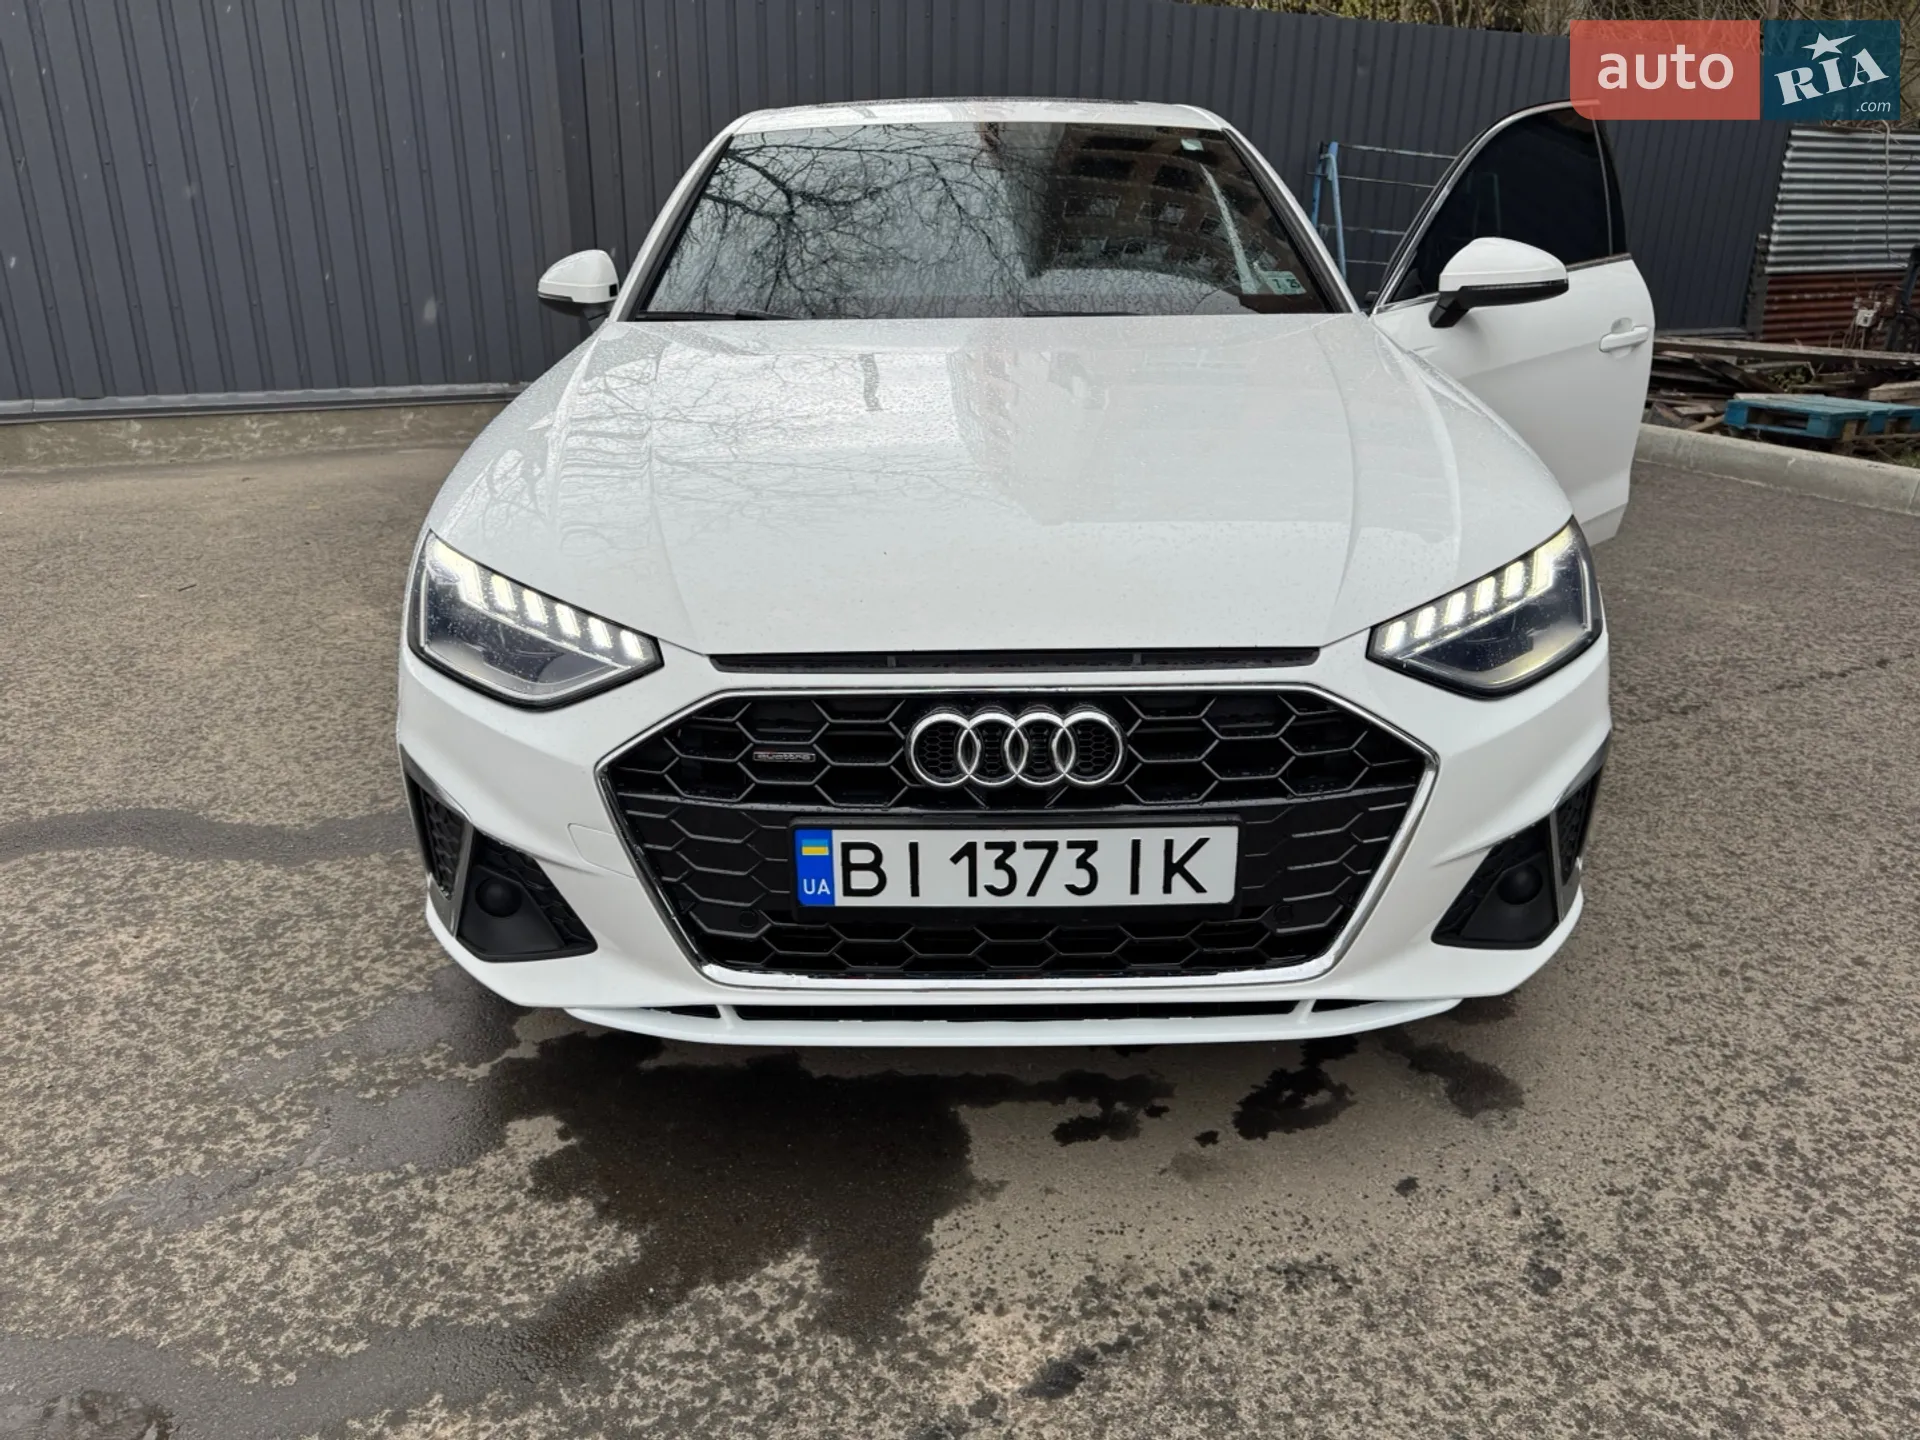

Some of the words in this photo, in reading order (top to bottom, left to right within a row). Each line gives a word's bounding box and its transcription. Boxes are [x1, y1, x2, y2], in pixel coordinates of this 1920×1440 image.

[840, 841, 920, 897] BI
[949, 840, 1099, 897] 1373
[1129, 837, 1211, 896] IK
[803, 878, 831, 895] UA
